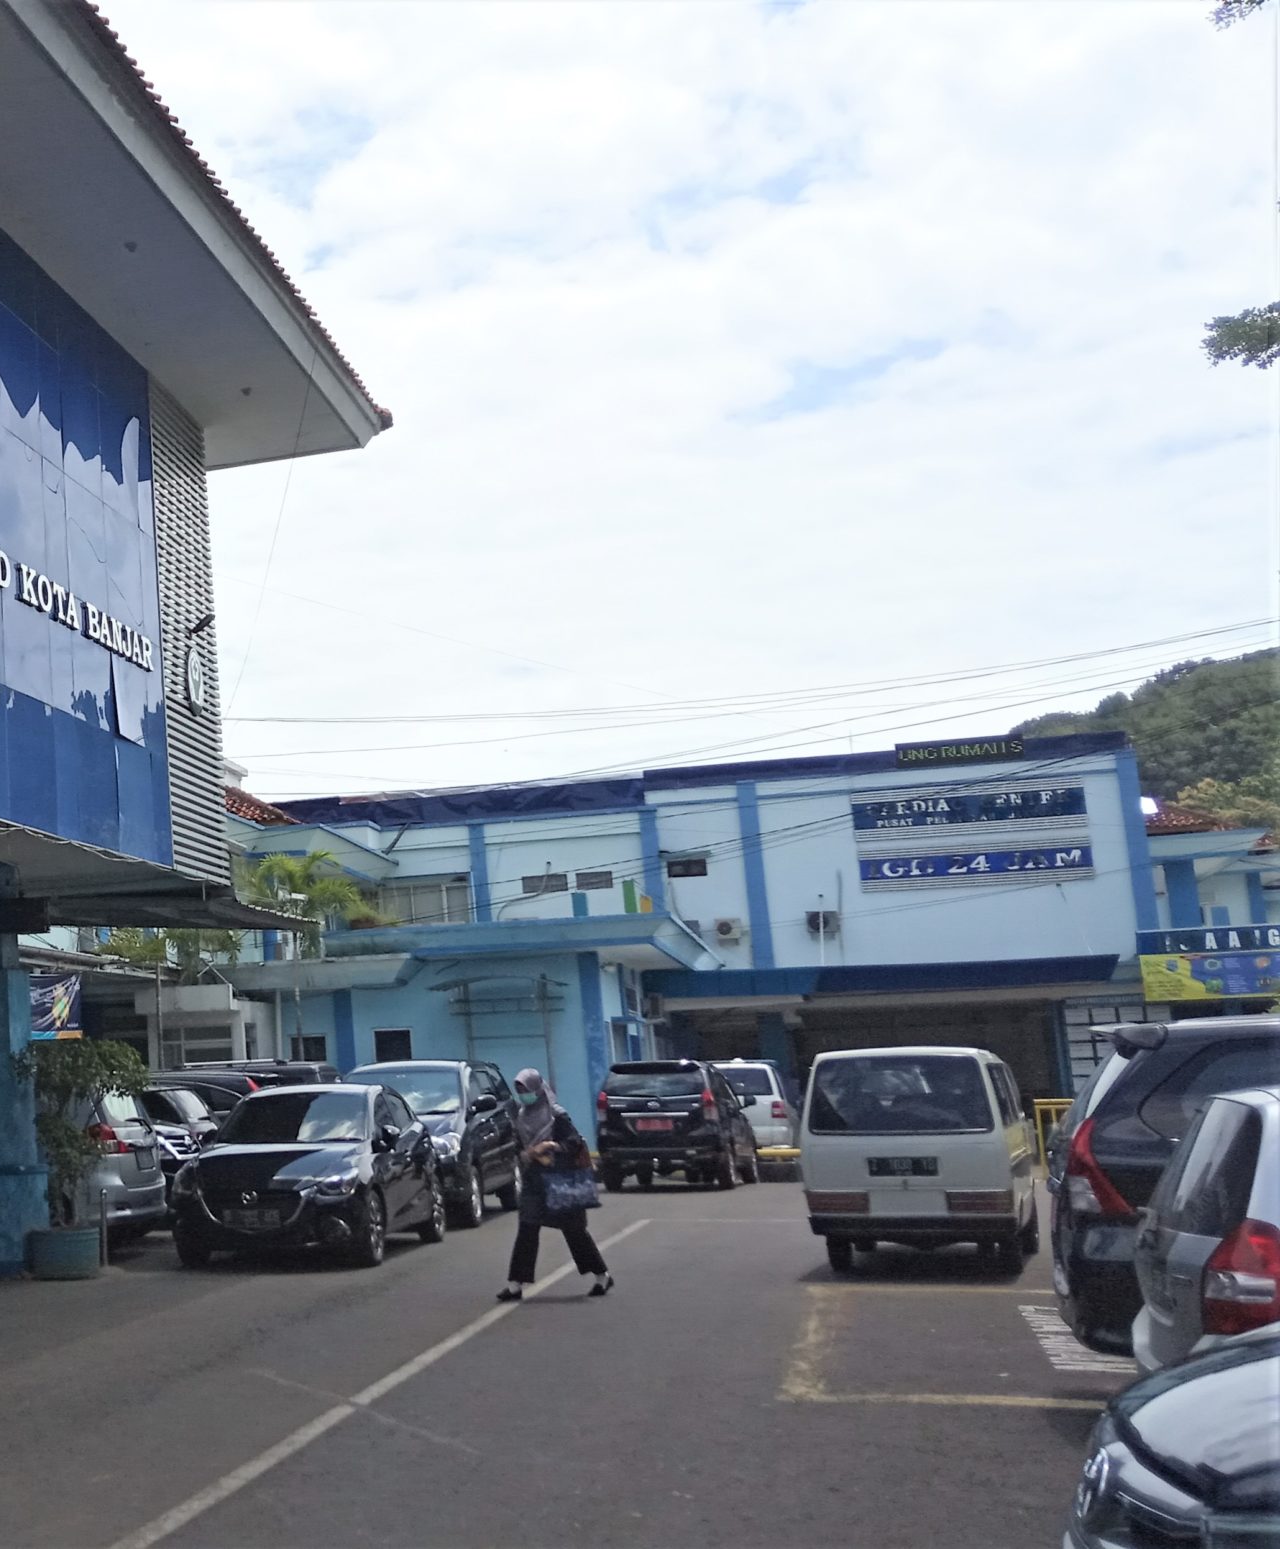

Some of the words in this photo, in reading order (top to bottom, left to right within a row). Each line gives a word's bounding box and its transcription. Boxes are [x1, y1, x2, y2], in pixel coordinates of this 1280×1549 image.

[16, 563, 80, 630] KOTA
[81, 602, 154, 672] BANJAR
[876, 818, 913, 828] PUSAT
[947, 855, 991, 874] 24
